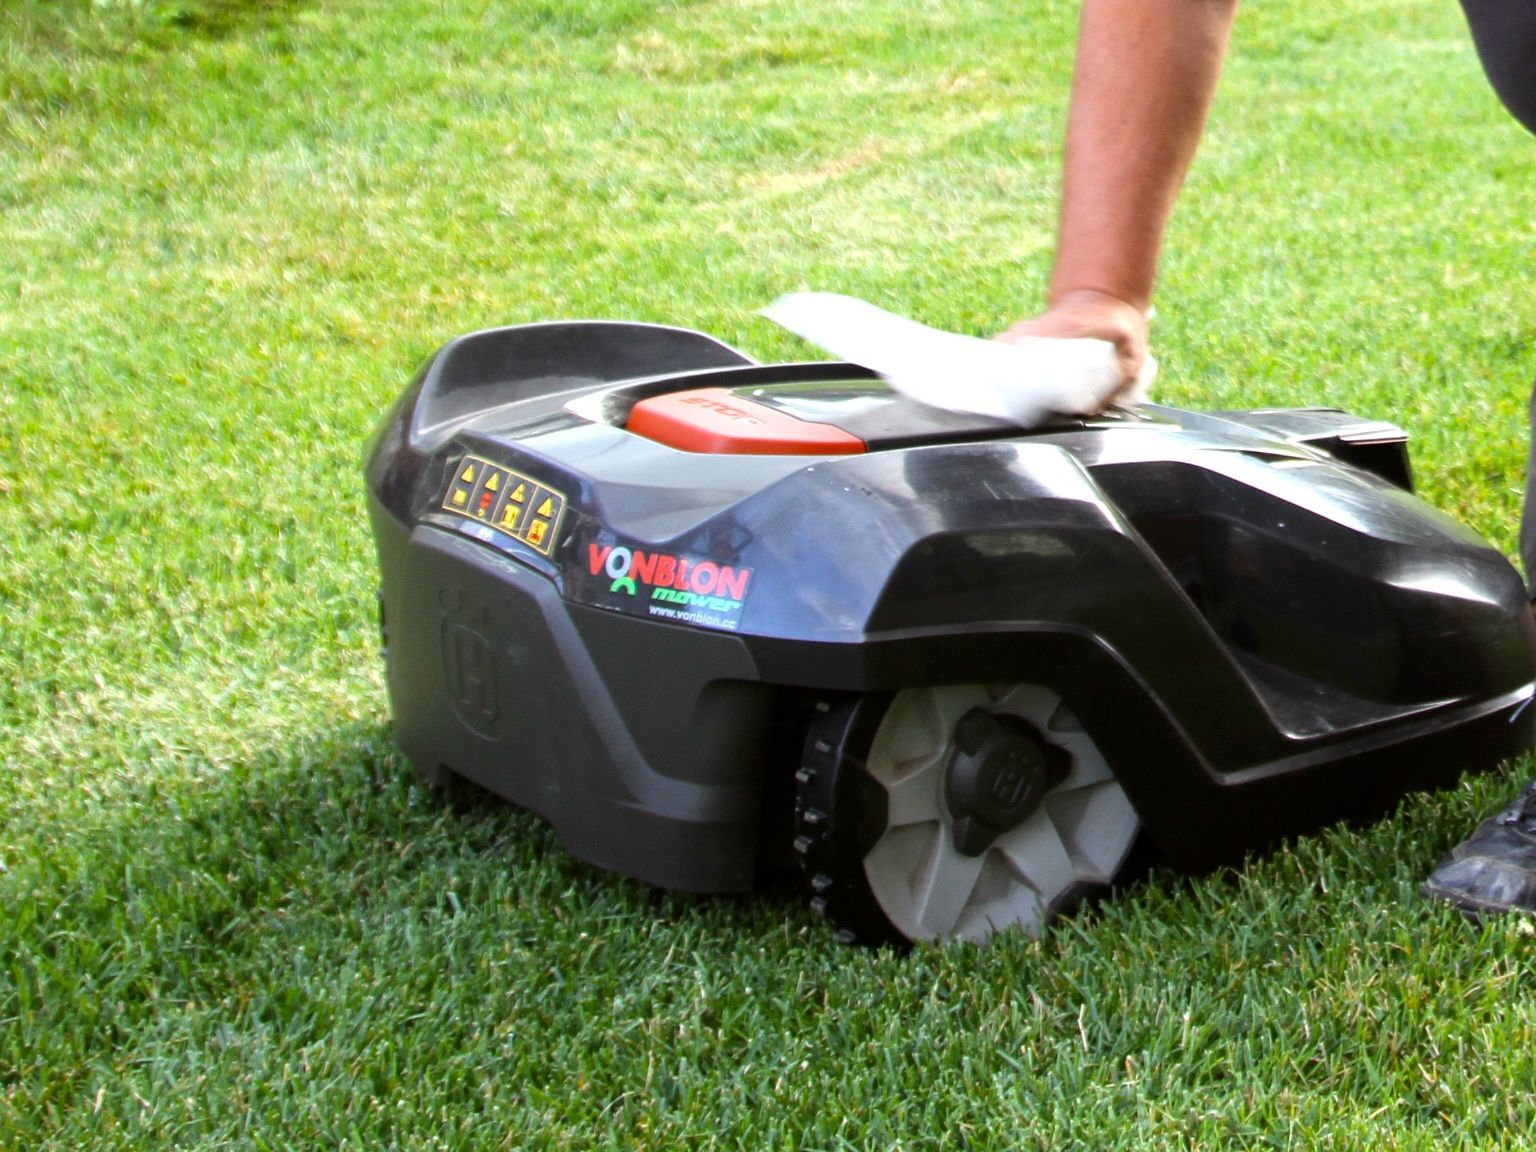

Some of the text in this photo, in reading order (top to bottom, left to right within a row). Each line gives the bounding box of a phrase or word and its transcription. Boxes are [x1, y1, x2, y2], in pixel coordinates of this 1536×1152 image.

[588, 543, 749, 600] VONBLON
[651, 587, 742, 612] mower
[649, 605, 737, 630] www.vonblon.cc
